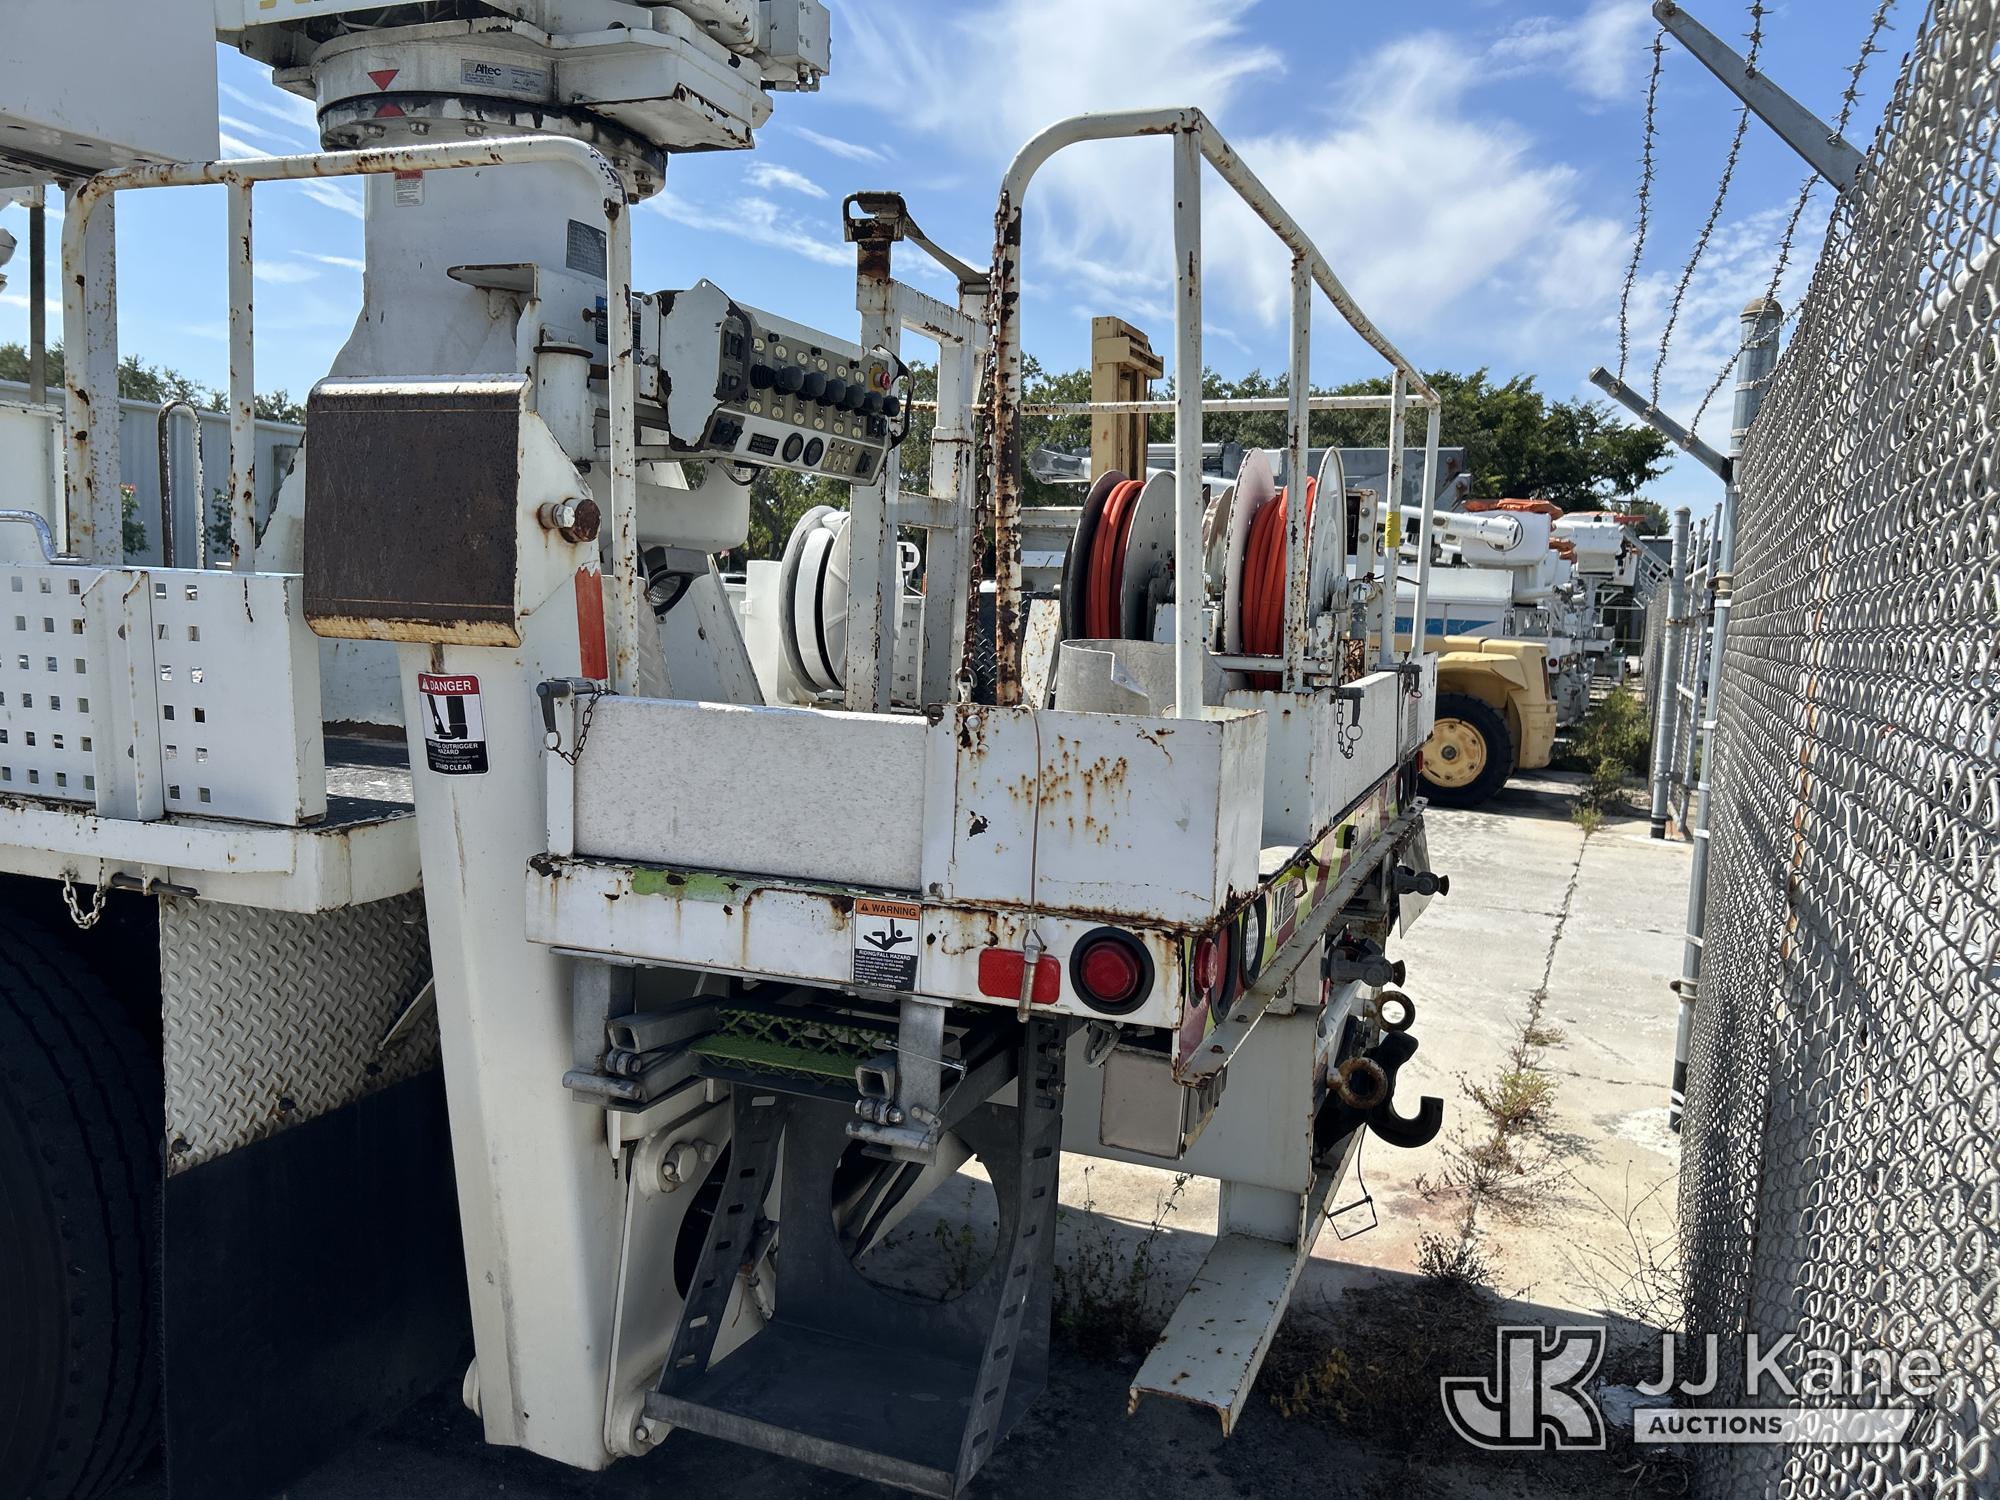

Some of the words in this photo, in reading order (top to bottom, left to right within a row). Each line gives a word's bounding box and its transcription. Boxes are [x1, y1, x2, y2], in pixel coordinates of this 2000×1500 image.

[475, 63, 502, 76] Altec
[430, 680, 472, 691] DANGER
[449, 763, 472, 771] CLEAR
[872, 903, 916, 917] WARNING
[890, 953, 911, 961] HAZARD
